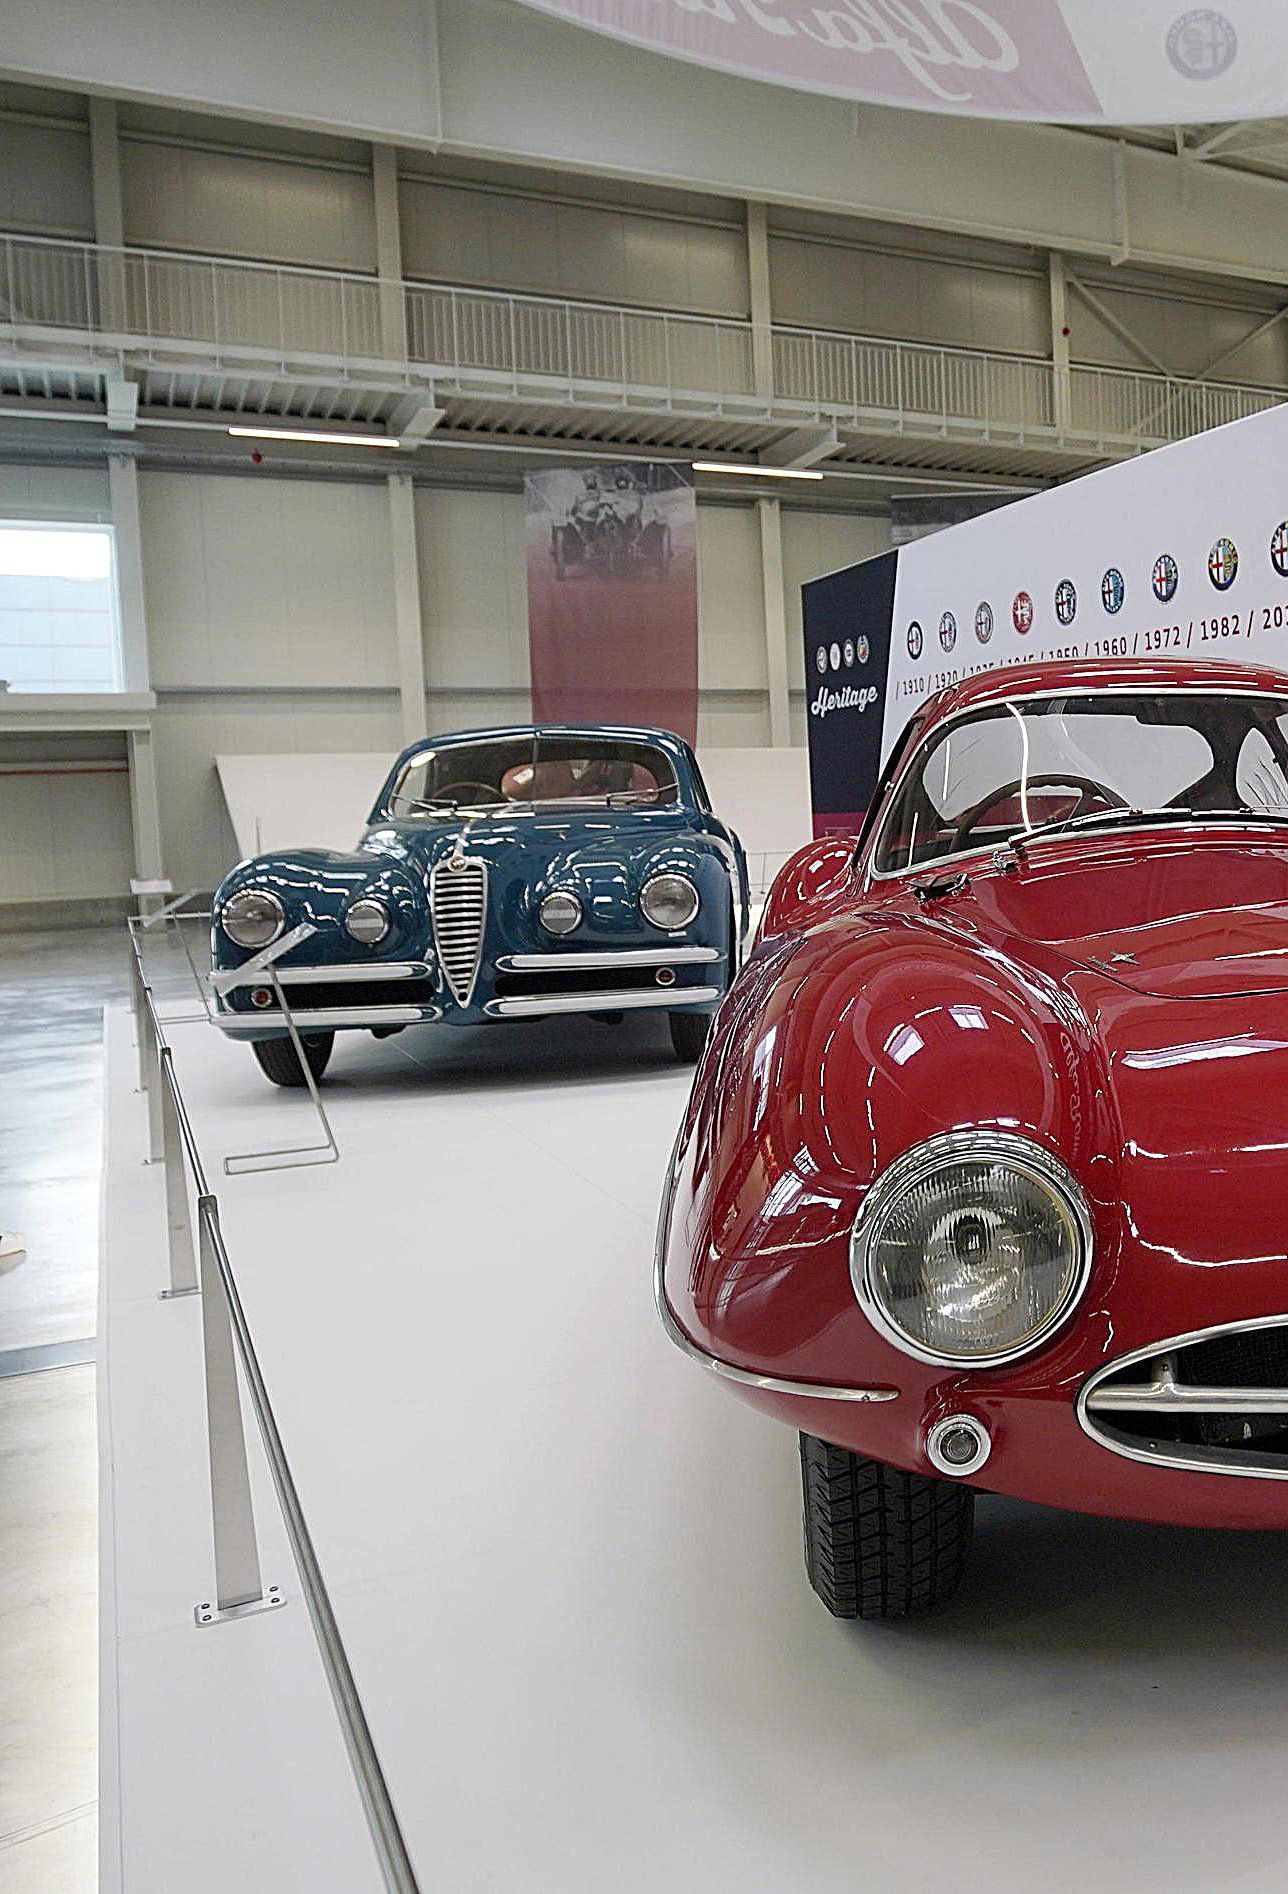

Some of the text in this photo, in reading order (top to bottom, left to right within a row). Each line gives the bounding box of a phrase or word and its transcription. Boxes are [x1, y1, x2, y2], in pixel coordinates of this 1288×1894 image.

[903, 677, 924, 696] 1910
[1094, 636, 1127, 657] 1960
[1145, 626, 1181, 651] 1972
[1200, 615, 1240, 641] 1982
[810, 686, 878, 718] Heritage
